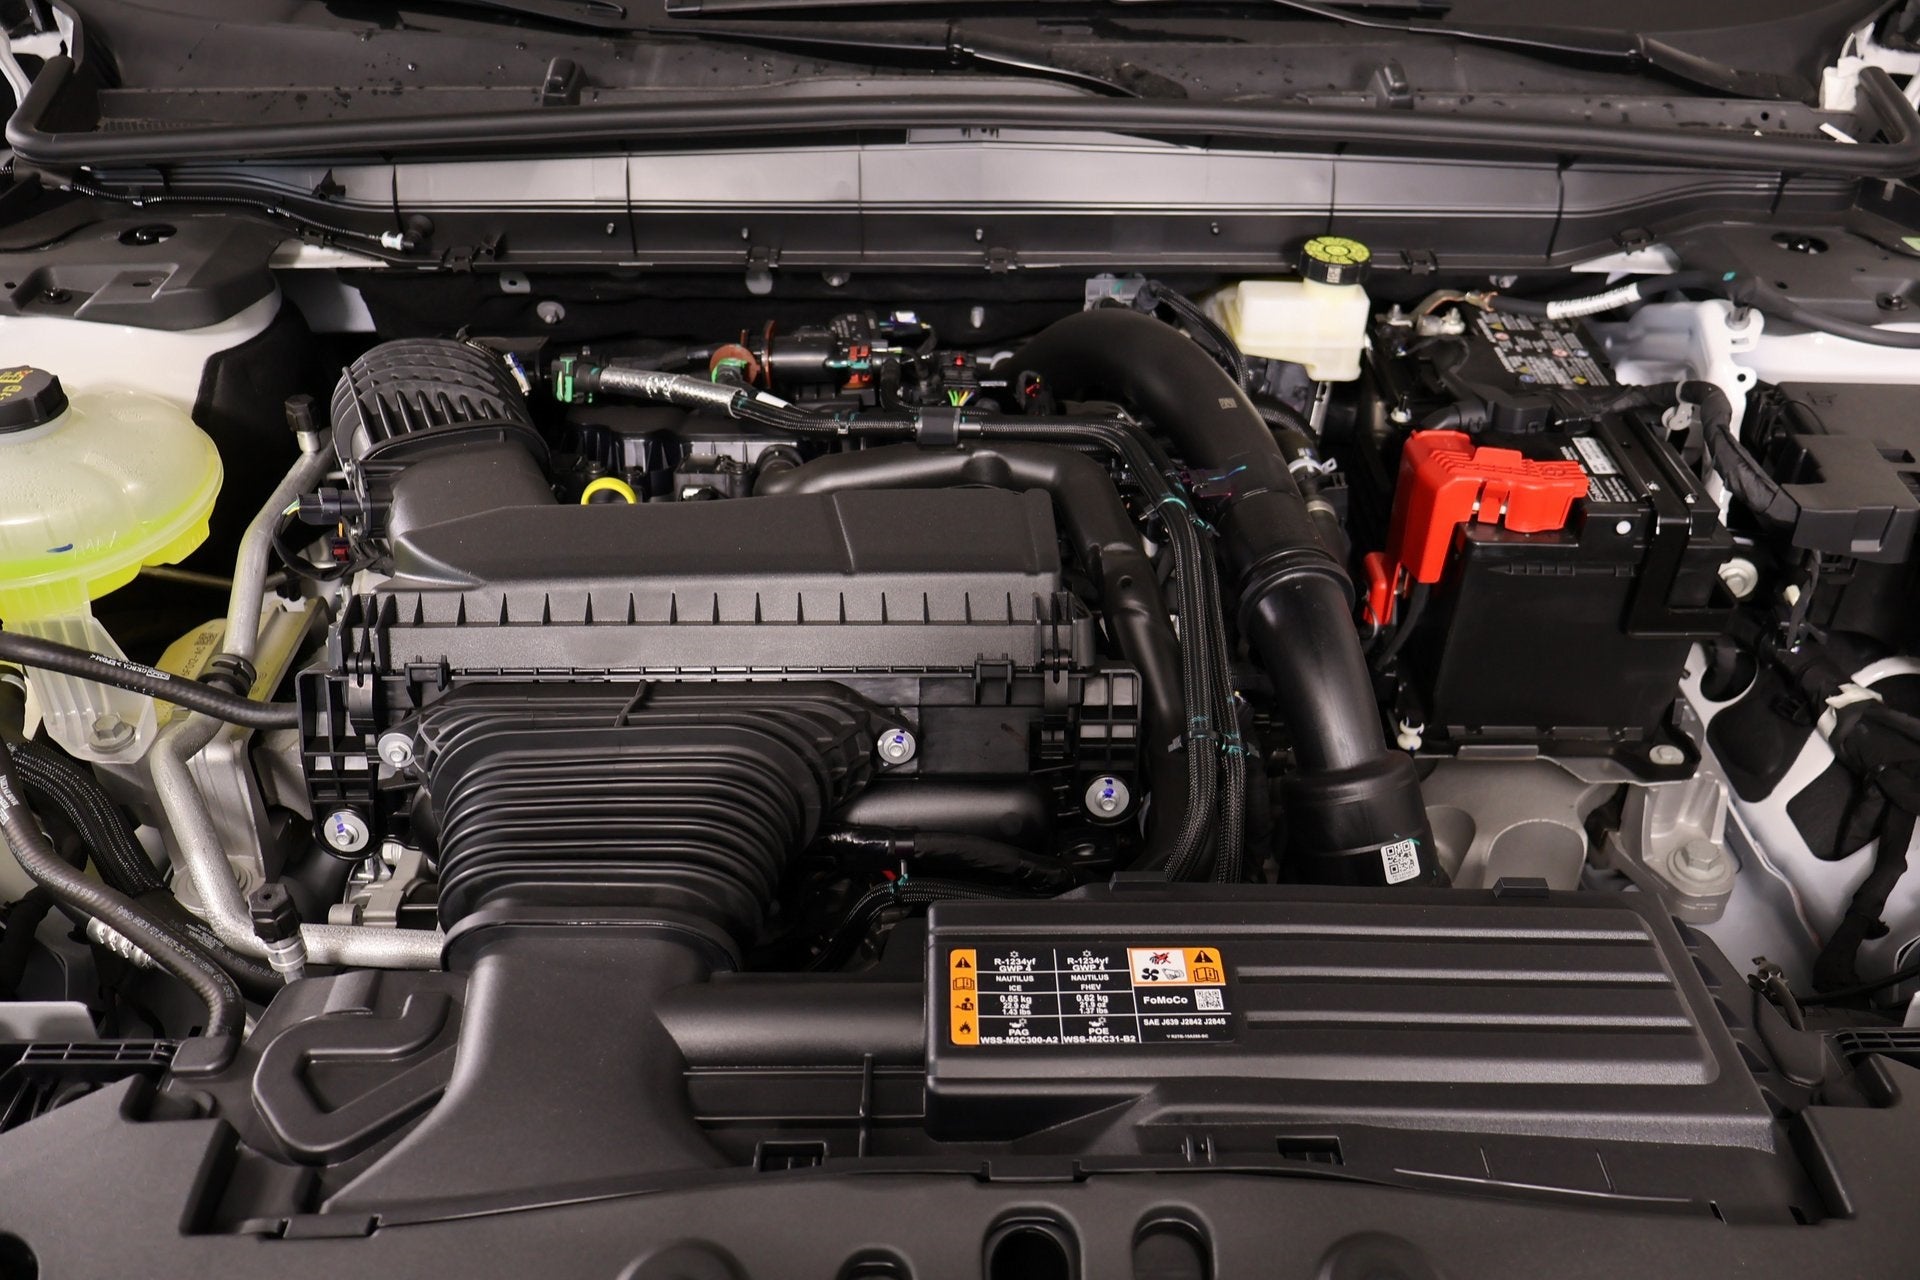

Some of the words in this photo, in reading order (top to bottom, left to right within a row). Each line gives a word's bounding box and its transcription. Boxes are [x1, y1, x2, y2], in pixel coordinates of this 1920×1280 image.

[994, 957, 1036, 966] R-1234yf
[1066, 957, 1109, 966] R-1234yf
[1020, 995, 1032, 1004] kg
[1096, 994, 1108, 1003] kg
[1143, 996, 1188, 1004] FoMoCo
